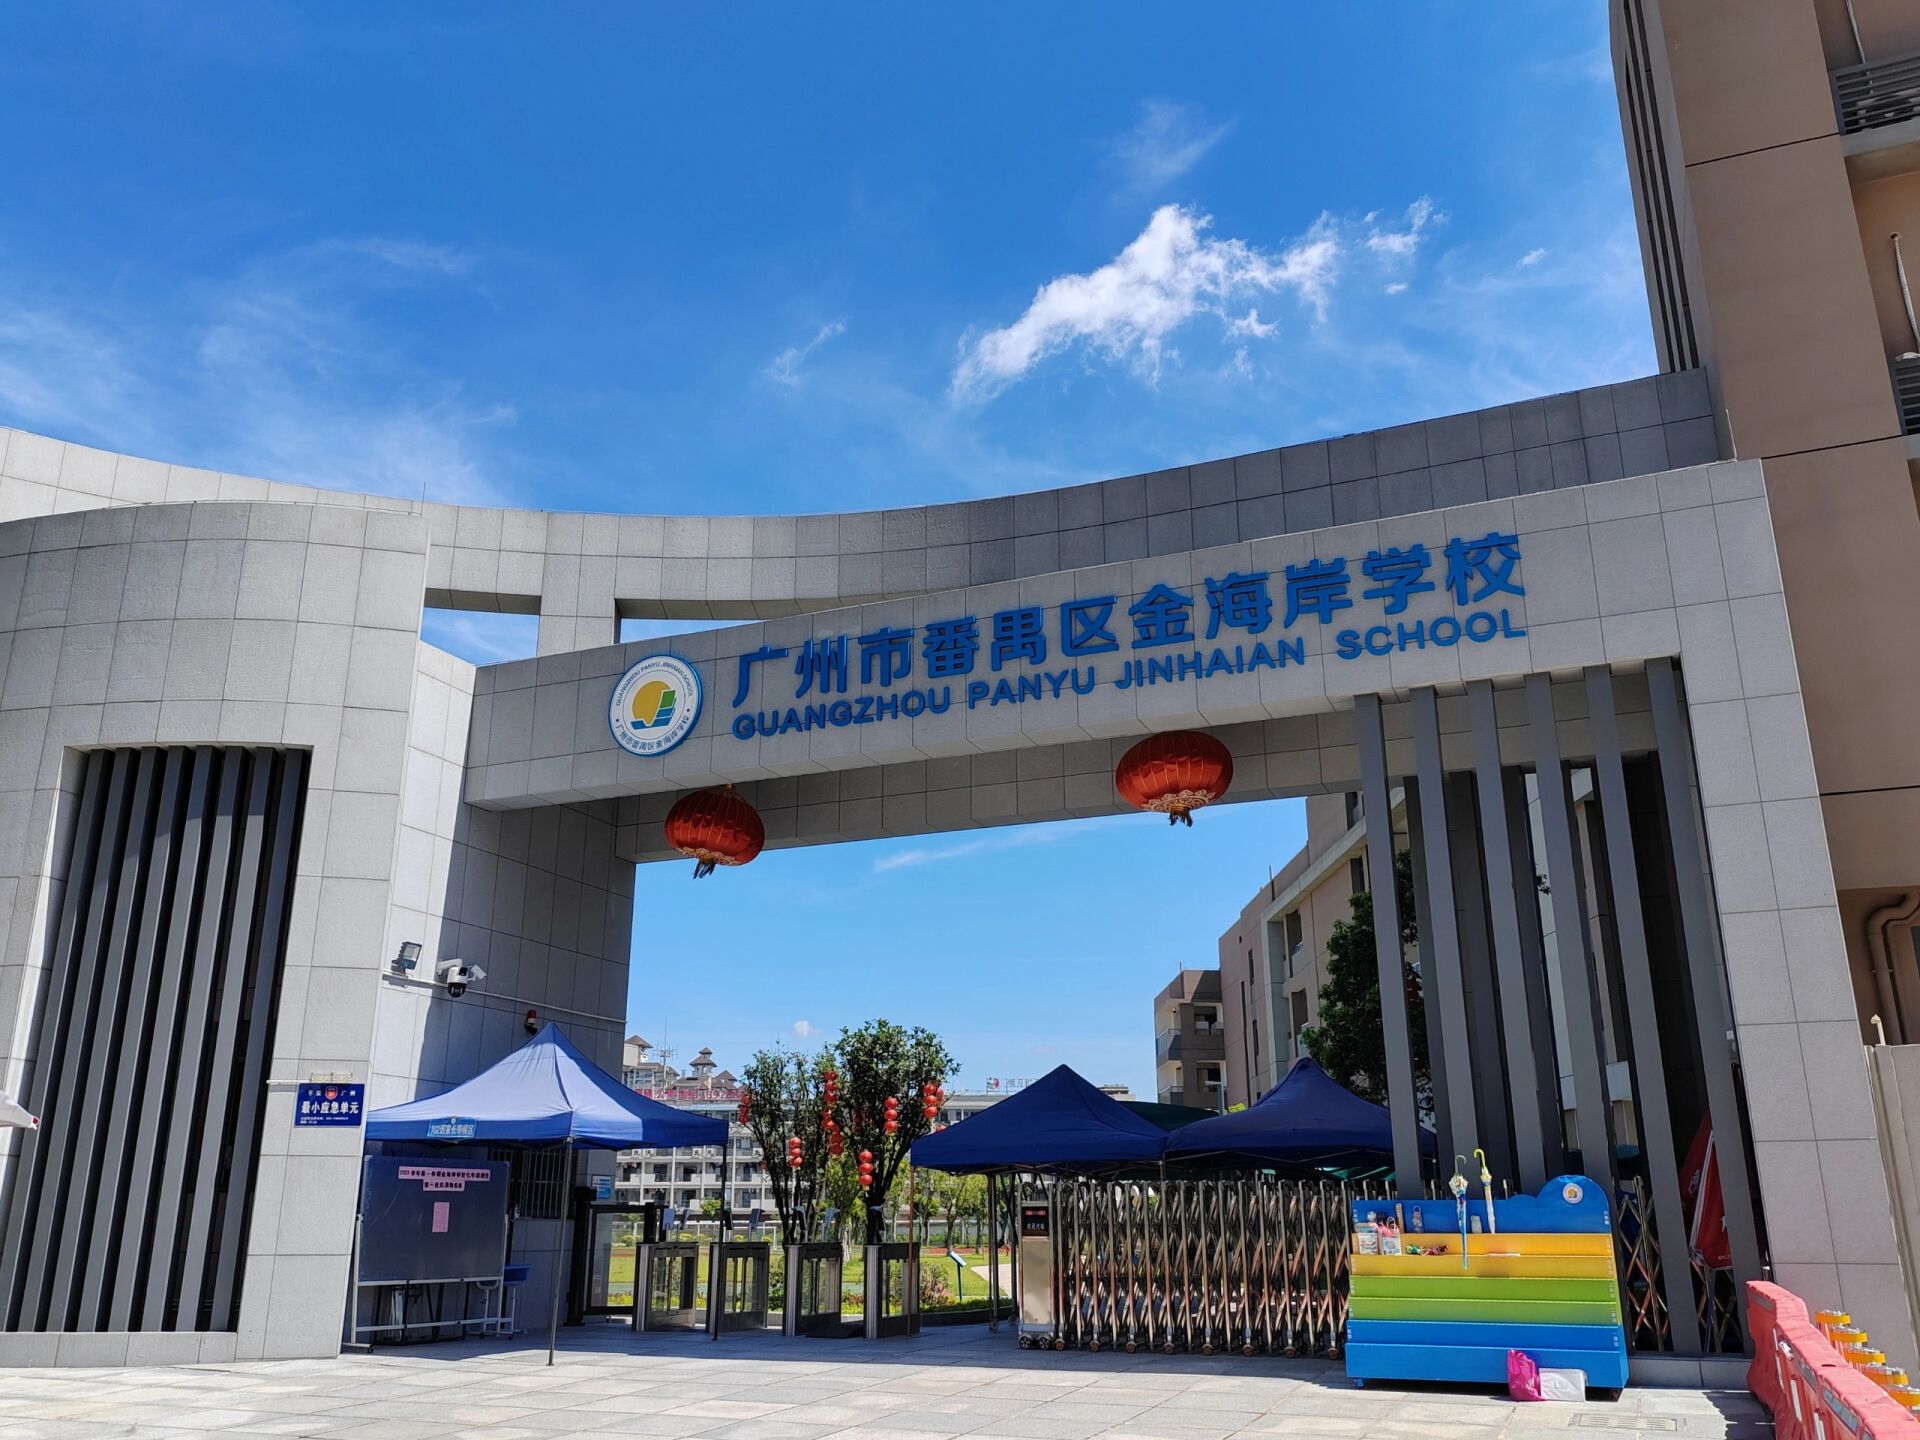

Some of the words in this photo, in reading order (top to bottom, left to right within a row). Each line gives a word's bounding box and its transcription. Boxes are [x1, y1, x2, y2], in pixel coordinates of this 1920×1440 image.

[731, 531, 1527, 709] 广州市番禺区金海岸学校
[615, 669, 641, 706] GUANGZHOU
[640, 661, 661, 673] PANYU
[682, 674, 694, 697] SCHOOL
[731, 686, 951, 741] GUANGZHOU
[966, 665, 1096, 711] PANYU
[1114, 635, 1306, 690] JINHAIAN
[1335, 608, 1527, 661] SCHOOL
[615, 715, 690, 751] 广州市番禺区金海岸学校
[300, 1100, 360, 1115] 最小应急单元
